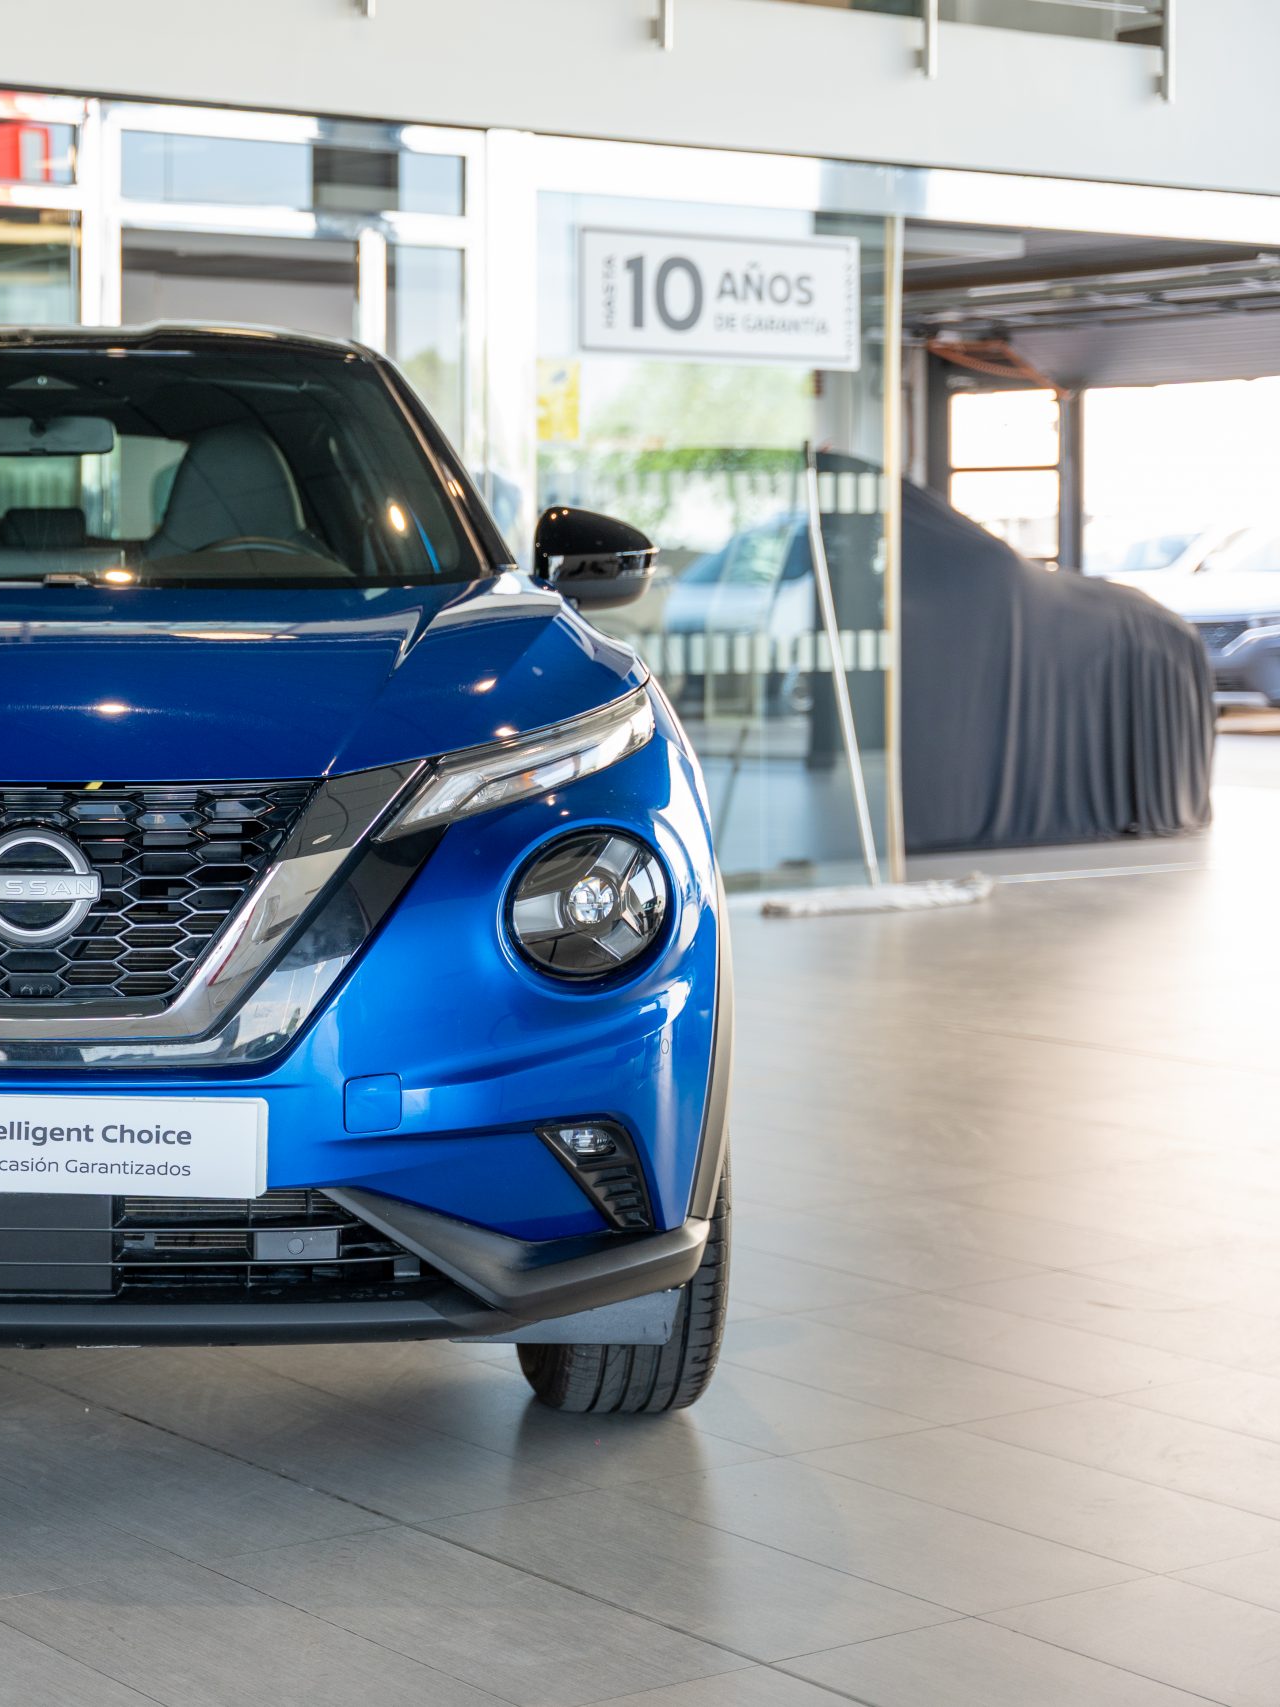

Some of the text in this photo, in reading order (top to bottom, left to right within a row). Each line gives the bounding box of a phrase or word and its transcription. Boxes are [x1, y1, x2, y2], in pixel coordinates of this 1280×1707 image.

[624, 255, 814, 331] 10 AÑOS
[101, 1123, 193, 1146] Choice
[65, 1158, 192, 1177] Garantizados
